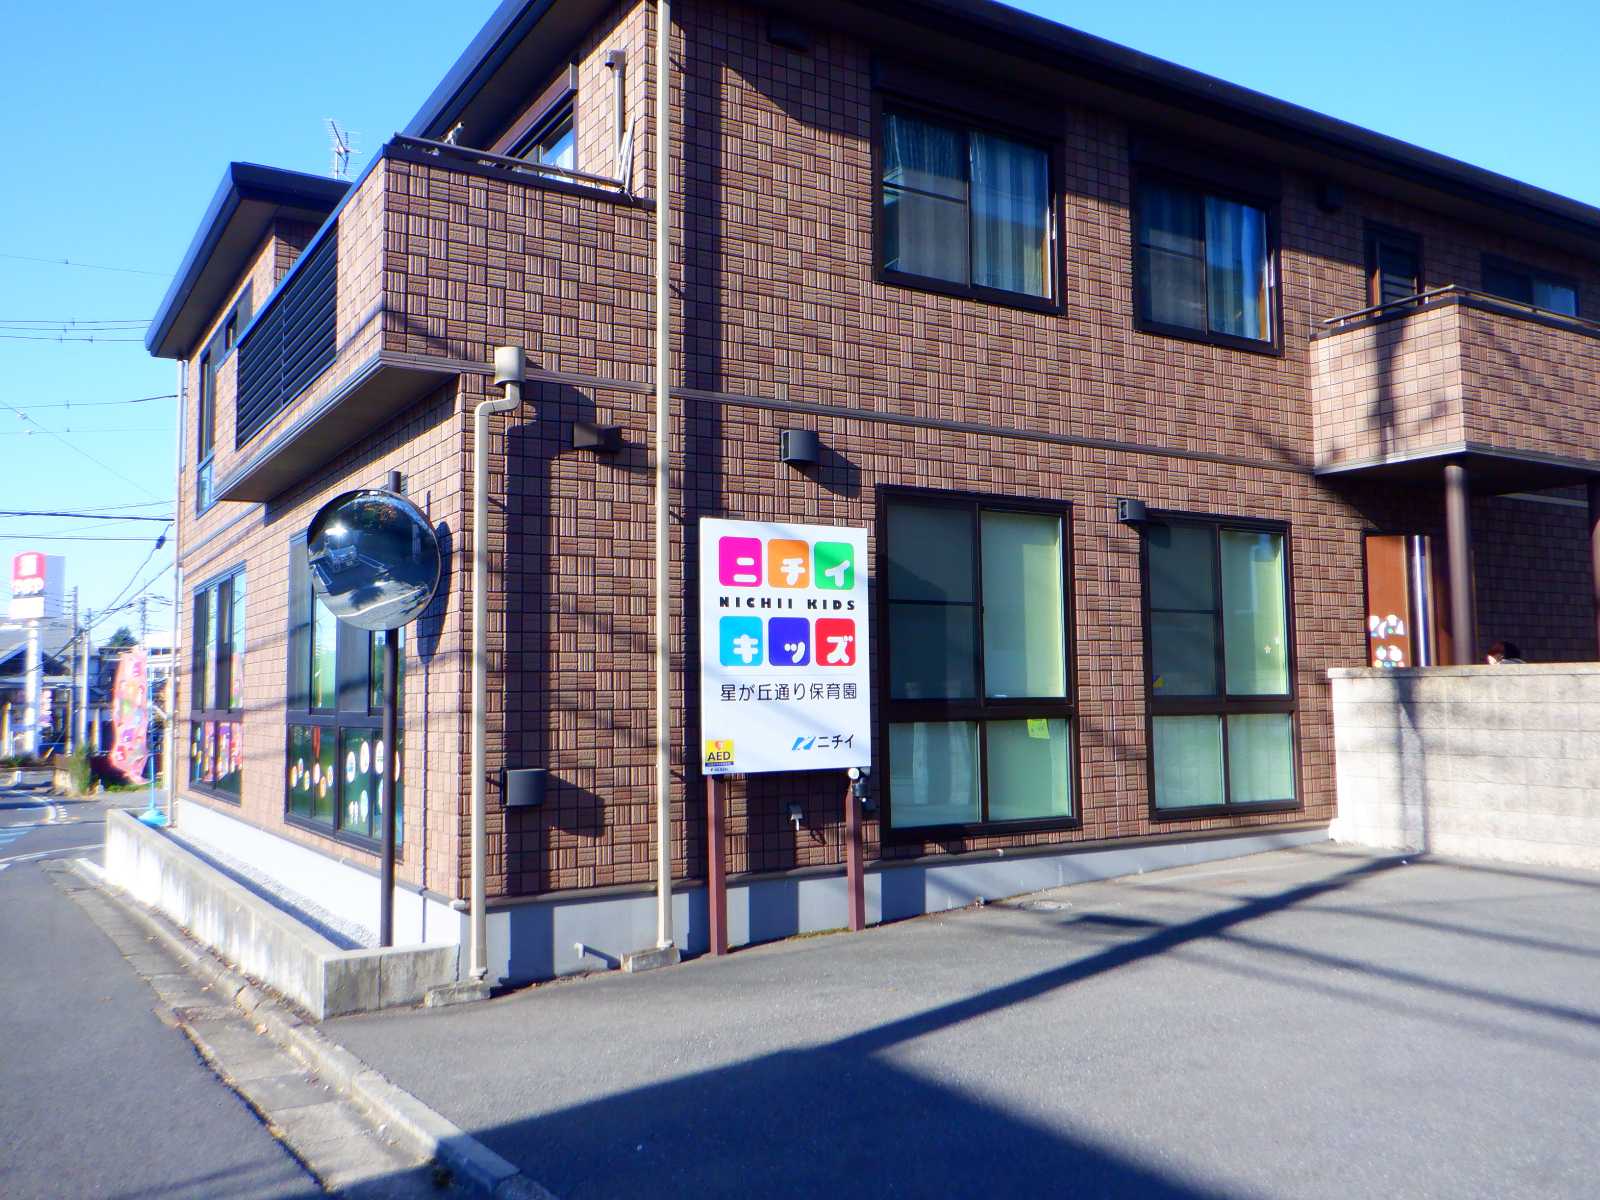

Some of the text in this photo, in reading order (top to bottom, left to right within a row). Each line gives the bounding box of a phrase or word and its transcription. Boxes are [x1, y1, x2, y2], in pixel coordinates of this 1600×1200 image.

[719, 597, 855, 610] NICHII KIDS
[720, 682, 857, 702] 星が丘通り保育園
[817, 734, 855, 750] ニチイ
[707, 751, 731, 761] AED
